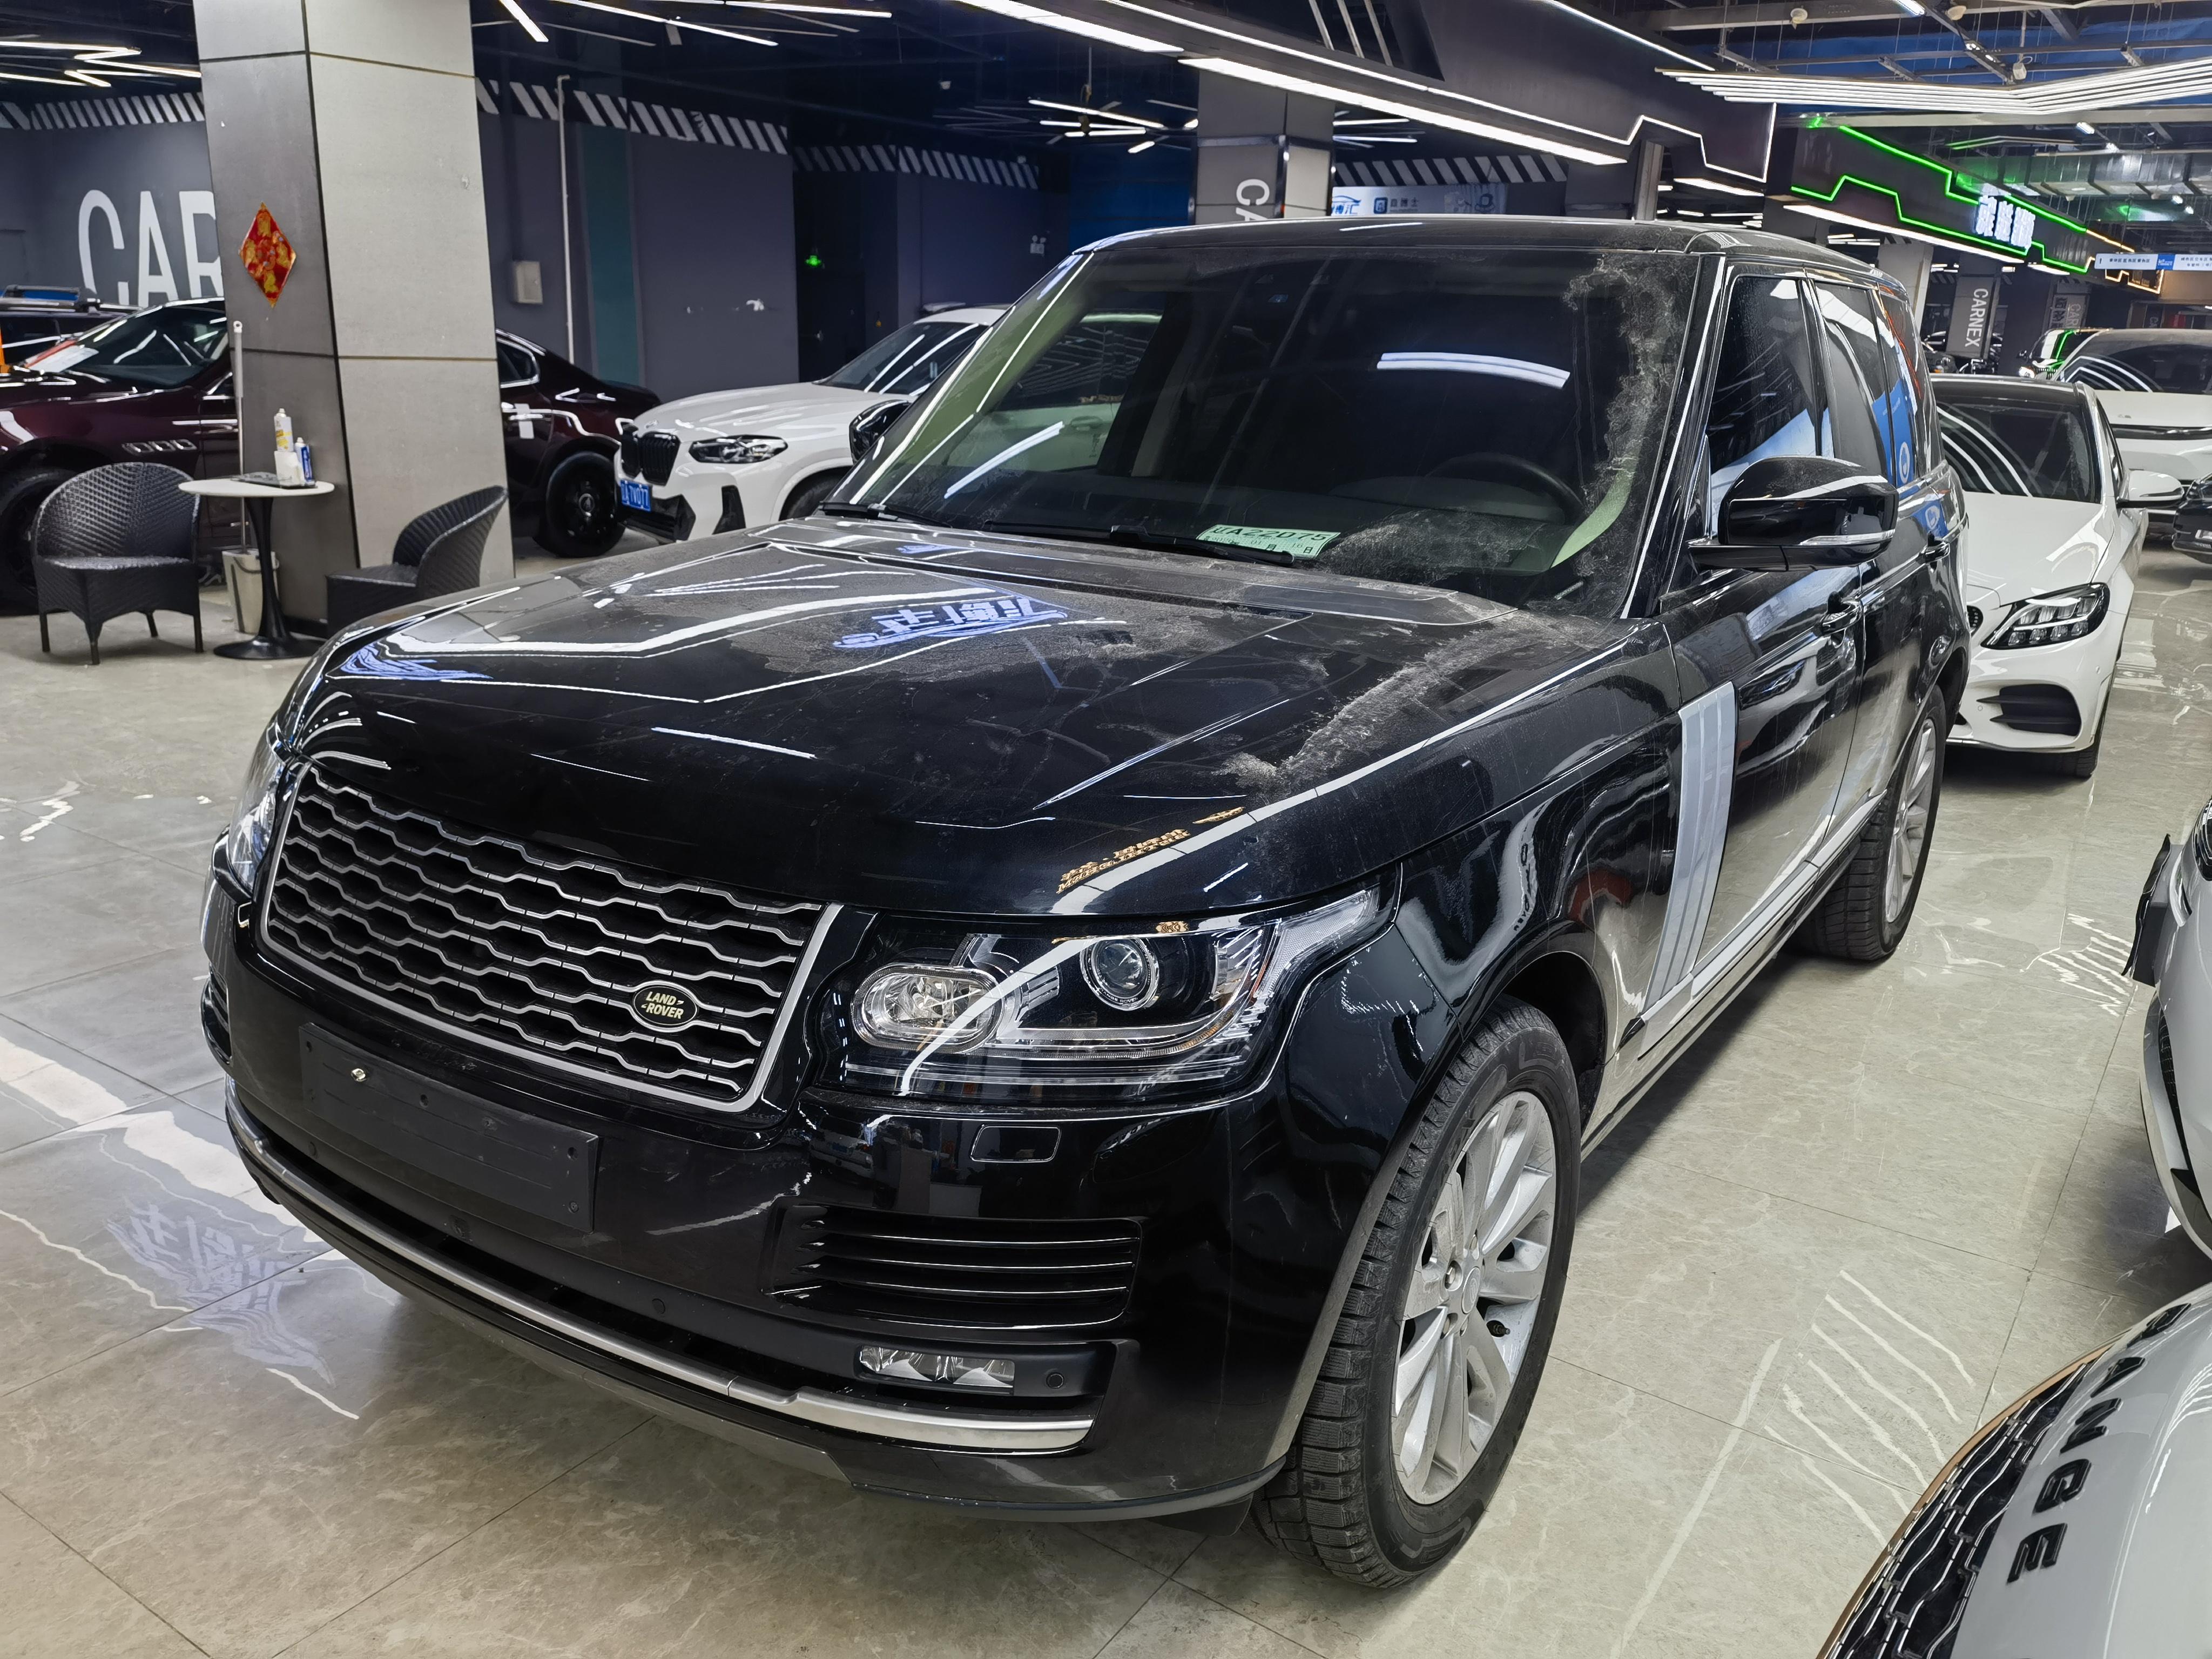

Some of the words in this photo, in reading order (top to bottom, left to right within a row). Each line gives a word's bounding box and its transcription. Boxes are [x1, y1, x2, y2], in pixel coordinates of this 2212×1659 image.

[1965, 288, 1988, 347] CARNEX
[646, 991, 677, 1006] LAND
[646, 1003, 684, 1020] ROVER
